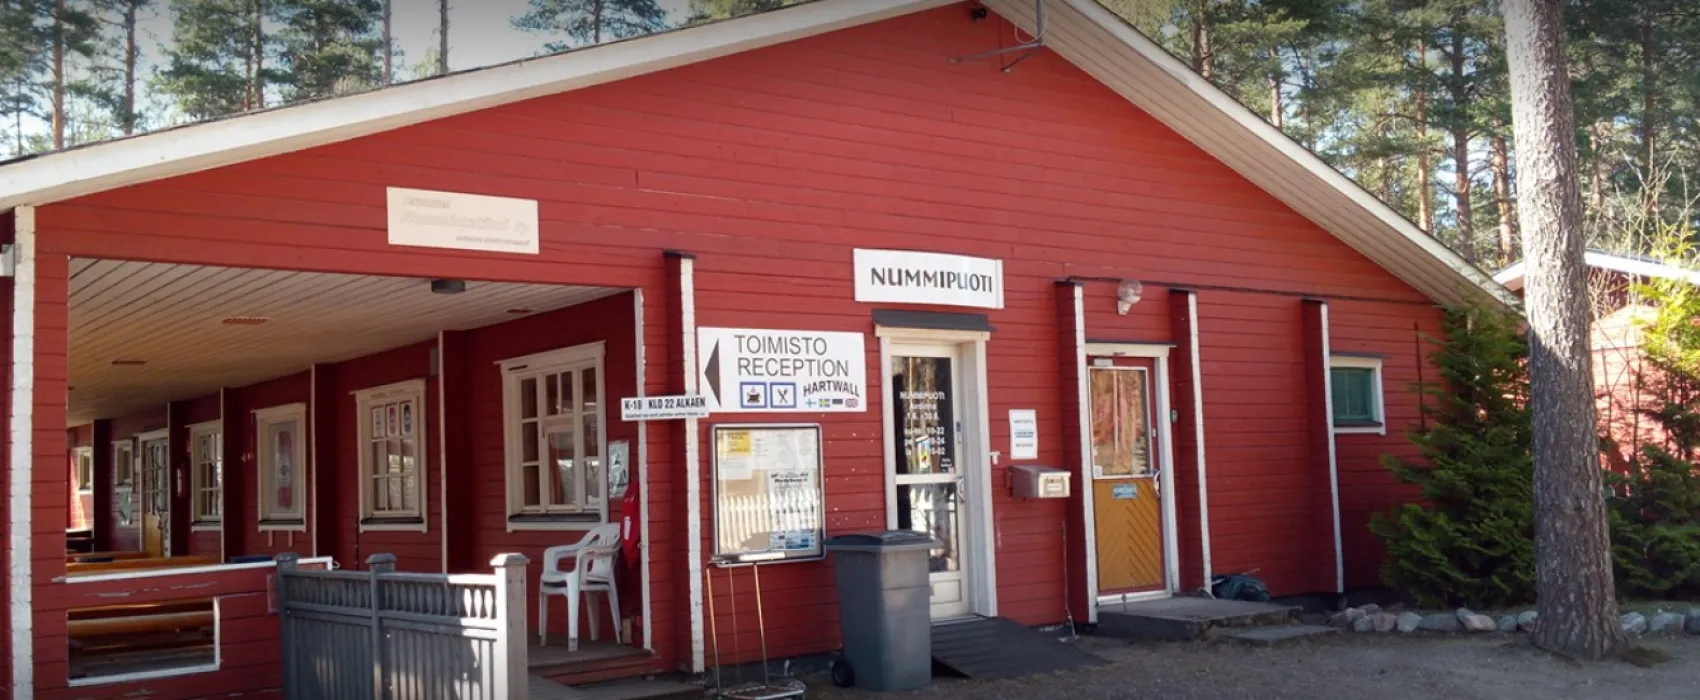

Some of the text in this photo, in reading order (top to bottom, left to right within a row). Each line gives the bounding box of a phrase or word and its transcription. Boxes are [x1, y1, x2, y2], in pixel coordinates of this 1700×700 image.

[871, 267, 992, 293] NUMMIPUOTI
[734, 334, 828, 356] TOIMISTO
[737, 357, 850, 378] RECEPTION
[802, 379, 861, 399] HARTWALL
[899, 390, 946, 400] NUMMIPUOTI
[624, 397, 706, 410] K-18 KLO 22 ALKAEN
